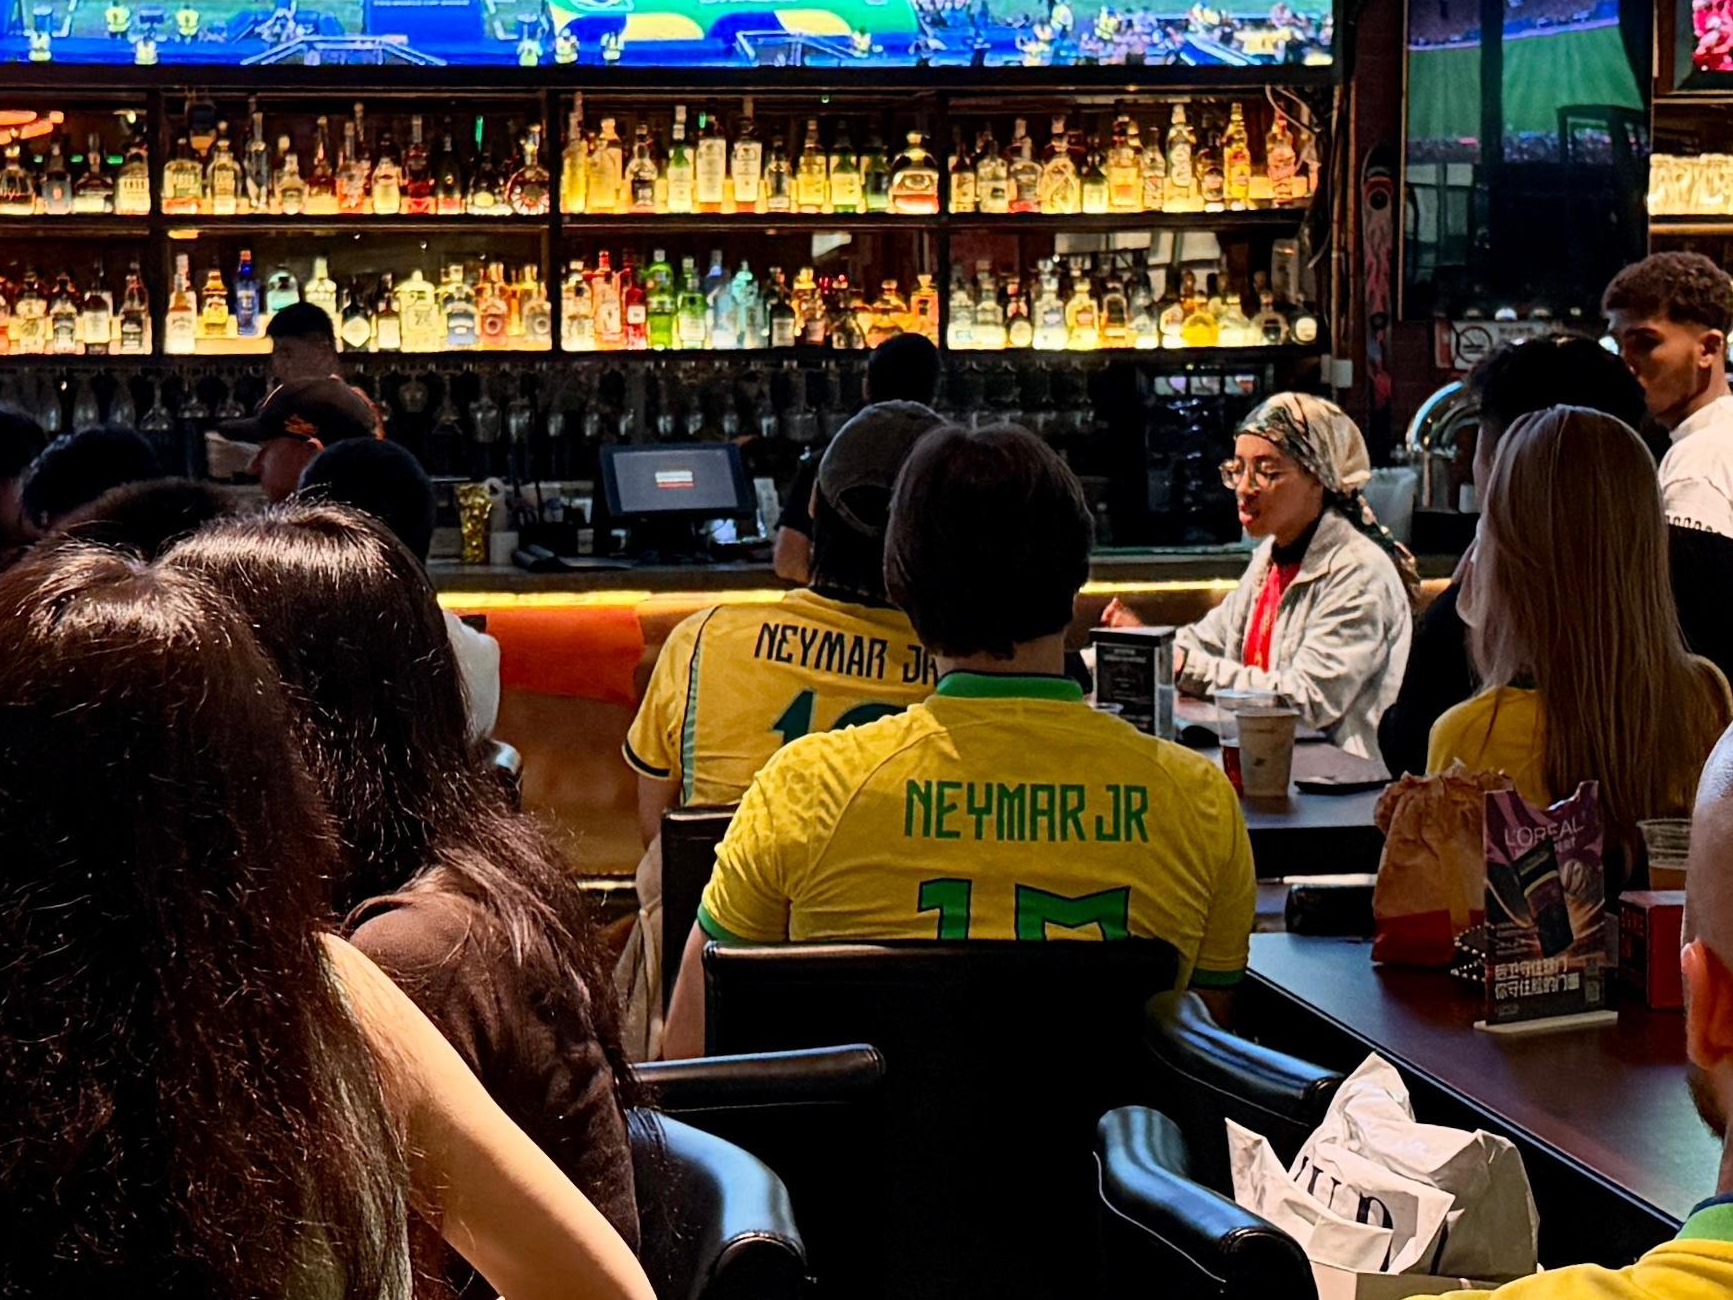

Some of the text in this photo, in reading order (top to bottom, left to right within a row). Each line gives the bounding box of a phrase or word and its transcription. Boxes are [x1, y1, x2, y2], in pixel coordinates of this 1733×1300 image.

[754, 623, 889, 680] NEYMAR
[904, 779, 1150, 843] NEYMAR JR
